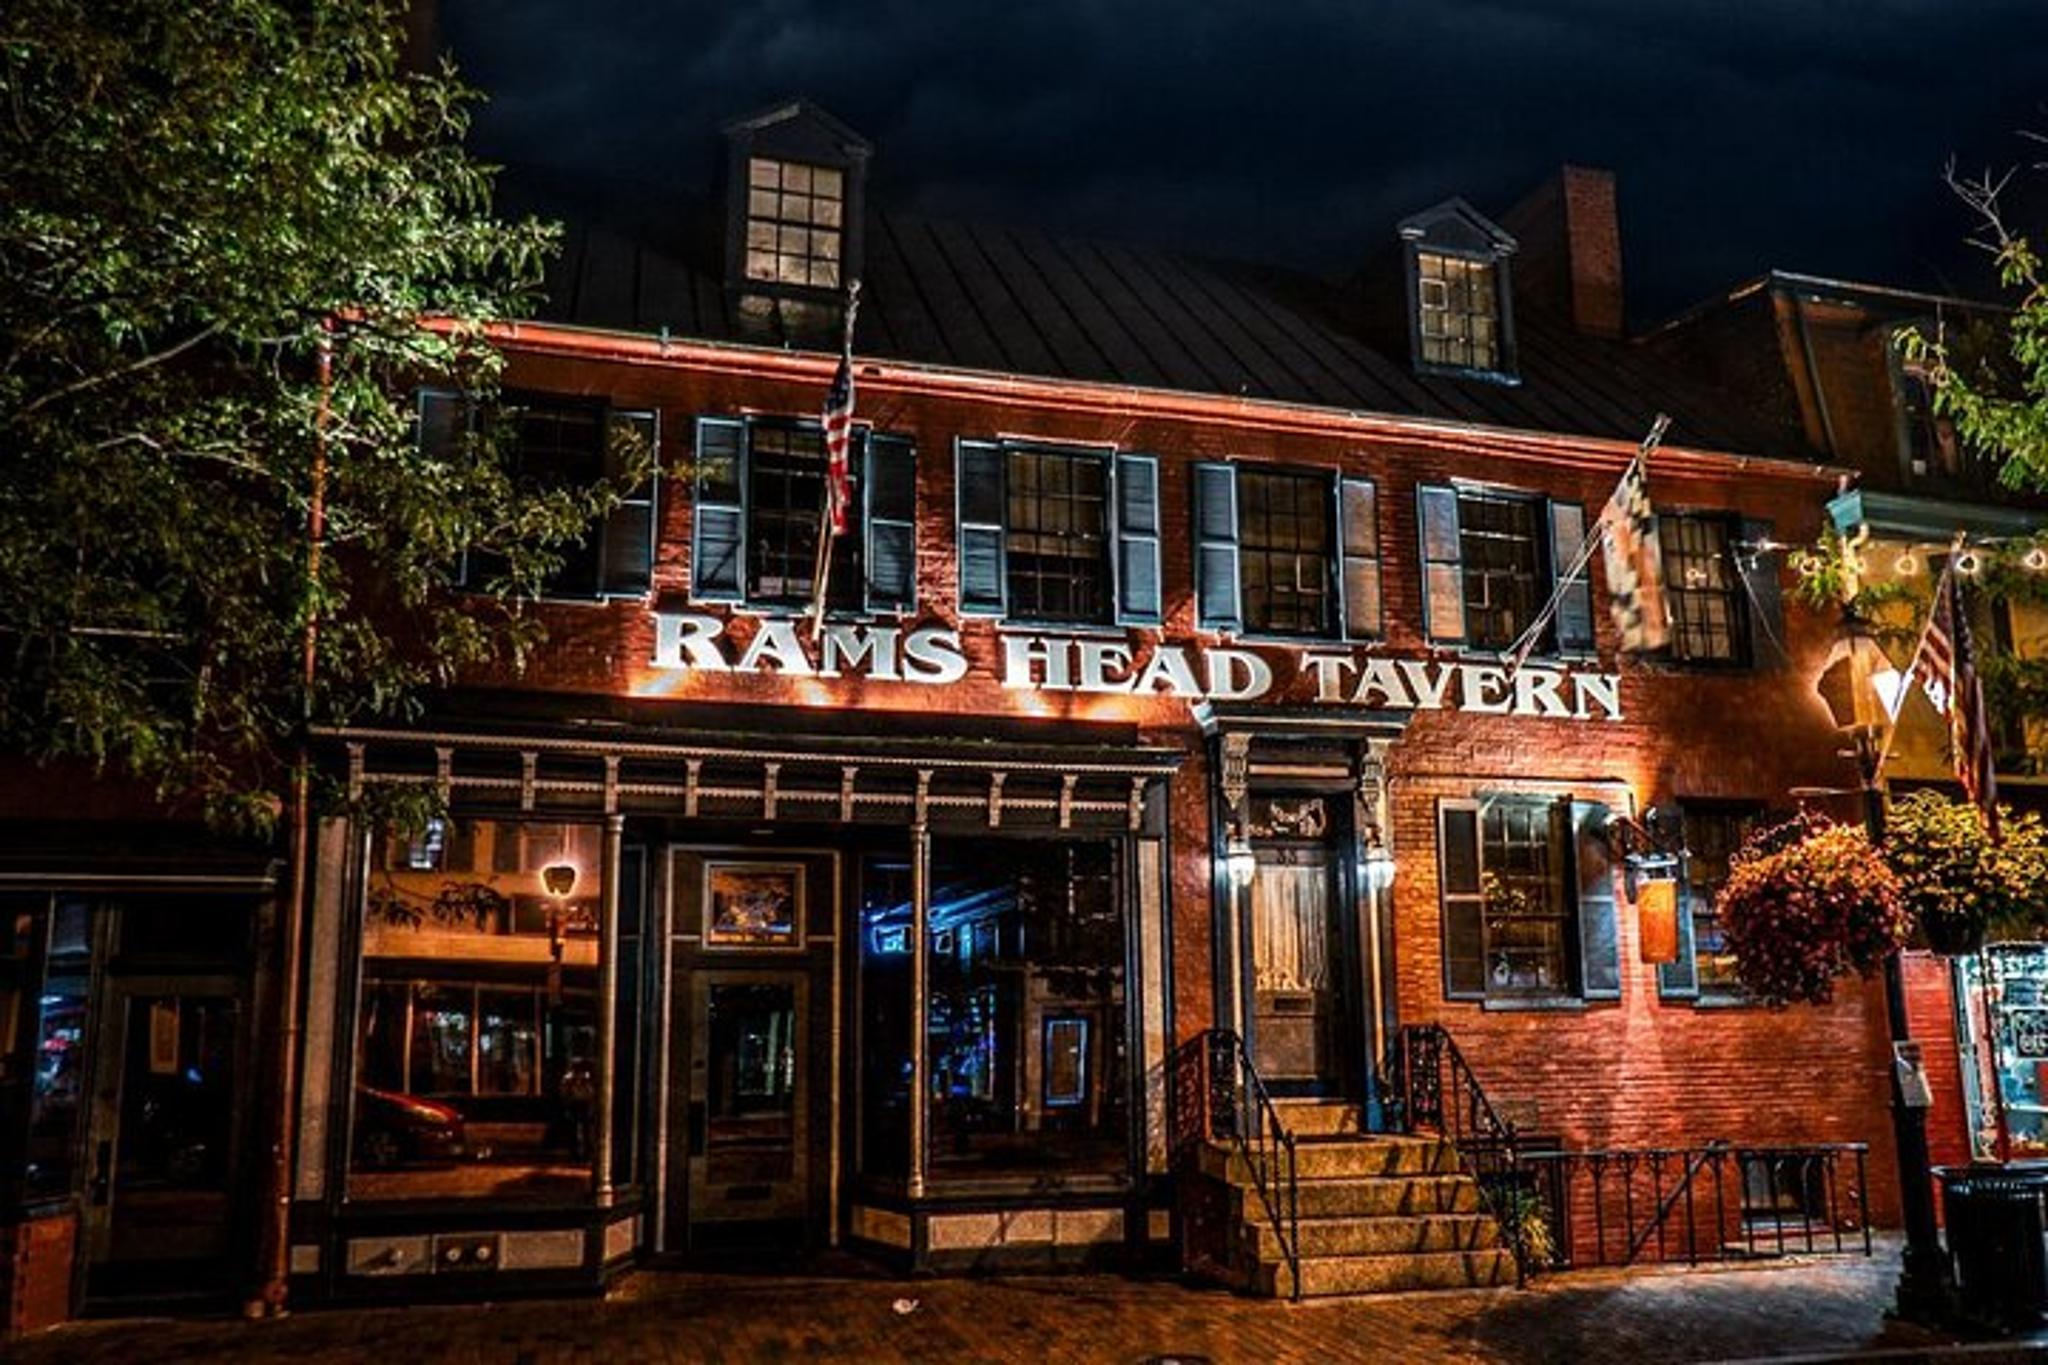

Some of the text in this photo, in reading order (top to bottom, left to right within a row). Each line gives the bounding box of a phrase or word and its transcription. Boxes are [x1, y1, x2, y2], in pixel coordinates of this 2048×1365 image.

[652, 612, 1624, 721] RAMS HEAD TAVERN
